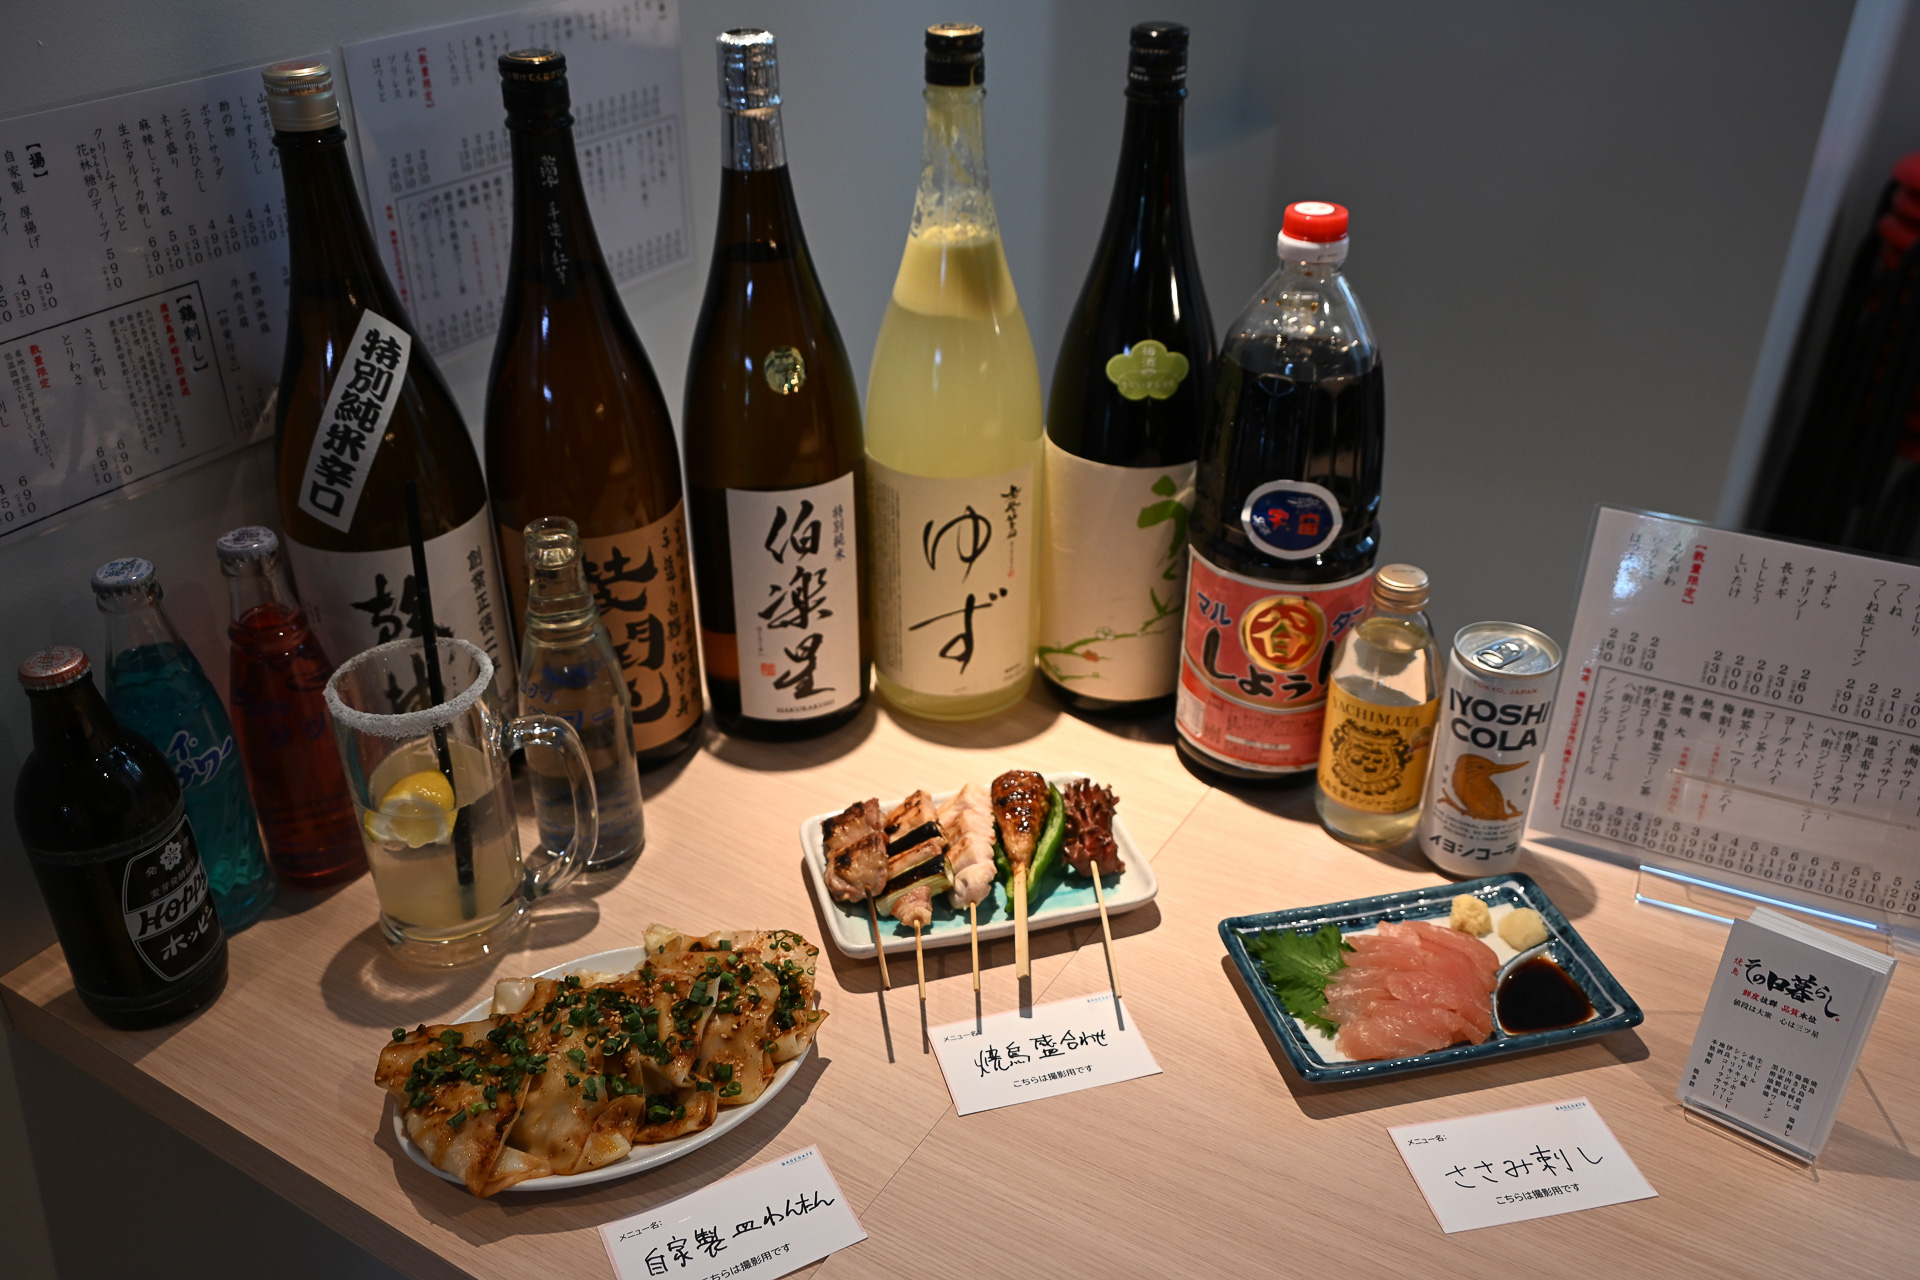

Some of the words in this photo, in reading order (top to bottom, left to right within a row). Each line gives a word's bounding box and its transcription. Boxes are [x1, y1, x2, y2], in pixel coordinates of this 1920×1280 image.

[218, 101, 236, 138] 酢の物
[239, 96, 262, 174] しらすおろし
[160, 114, 180, 169] ネギ盛り
[180, 109, 206, 193] ニラのおひたし
[199, 103, 225, 181] ポテトサラダ
[26, 142, 49, 179] 【揚】
[118, 123, 153, 229] 生ホタルイカ刺し
[138, 118, 173, 216] 麻辣しらす冷奴
[76, 144, 111, 243] 花林糖のディップ
[94, 128, 128, 232] クリームチーズと
[5, 151, 27, 195] 自家製
[20, 205, 42, 250] 厚揚げ
[208, 219, 223, 258] 490
[227, 214, 241, 253] 450
[245, 209, 259, 247] 450
[264, 203, 277, 242] 450
[148, 236, 165, 276] 690
[169, 230, 185, 270] 590
[188, 225, 204, 264] 530
[106, 248, 123, 289] 590
[17, 275, 36, 316] 490
[40, 267, 58, 309] 490
[176, 293, 209, 373] 【鶏刺し】
[29, 344, 52, 390] 数量限定
[62, 334, 83, 386] とりわさ
[84, 327, 108, 391] ささみ刺し
[308, 327, 403, 517] 特別純米辛口
[95, 447, 113, 484] 690
[116, 439, 133, 476] 690
[18, 476, 37, 514] 690
[908, 504, 1008, 676] ゆず
[1681, 543, 1709, 606] 【数量限定】
[1727, 552, 1748, 599] しいたけ
[1752, 557, 1767, 605] ししとう
[1774, 561, 1794, 600] 長ネギ
[1820, 571, 1837, 609] うずら
[1196, 590, 1233, 627] マル
[1796, 566, 1818, 621] チョリソー
[1888, 582, 1910, 617] つくね
[1851, 578, 1887, 667] つくね生ピーマン
[1602, 627, 1619, 663] 260
[1623, 631, 1640, 668] 290
[1643, 635, 1660, 672] 230
[1706, 649, 1724, 686] 230
[1728, 654, 1745, 691] 200
[1749, 659, 1767, 695] 200
[1771, 664, 1789, 700] 230
[1509, 687, 1538, 696] JAPAN
[1793, 668, 1811, 705] 260
[1838, 678, 1856, 715] 290
[1860, 683, 1878, 719] 230
[1332, 695, 1421, 729] YACHIMATA
[1449, 686, 1551, 726] IYOSHI
[1635, 684, 1657, 738] 伊良コーラ
[1679, 693, 1695, 719] 熱燗
[1699, 698, 1715, 723] 熱燗
[1717, 702, 1736, 740] 梅割り
[1883, 688, 1902, 725] 210
[1450, 717, 1538, 752] COLA
[1584, 675, 1617, 775] ノンアルコールビール
[1602, 681, 1637, 782] 八街ジンジャーエール
[1674, 726, 1687, 739] 大
[1750, 711, 1776, 770] コーン茶ハイ
[1768, 715, 1796, 785] ヨーグルトハイ
[1795, 720, 1815, 769] トマトハイ
[1852, 733, 1879, 804] 塩昆布サワー
[1876, 738, 1903, 800] バイスサワー
[1898, 743, 1920, 801] 梅肉サワー
[1573, 796, 1588, 829] 590
[1591, 801, 1606, 834] 590
[1610, 806, 1625, 839] 590
[1628, 811, 1644, 844] 450
[1429, 834, 1517, 861] イヨシコーラ
[1647, 816, 1662, 850] 990
[1666, 821, 1682, 854] 500
[1685, 826, 1701, 860] 390
[1704, 831, 1720, 864] 490
[1723, 836, 1739, 869] 490
[1743, 841, 1760, 875] 510
[1763, 846, 1779, 880] 510
[1783, 851, 1800, 885] 690
[1804, 856, 1820, 890] 690
[1824, 861, 1841, 895] 510
[1844, 866, 1861, 900] 520
[1865, 871, 1882, 905] 510
[1885, 876, 1902, 911] 520
[1730, 956, 1744, 977] 焼鳥
[1744, 957, 1841, 1019] その日暮らし
[1732, 998, 1774, 1020] 値段は大衆
[1779, 1017, 1820, 1040] 心は三ツ星
[1741, 988, 1779, 1008] 鮮度抜群
[1781, 1004, 1818, 1025] 品質本位
[1703, 1038, 1719, 1066] 本格焼酎
[1716, 1041, 1726, 1056] 地酒
[1746, 1054, 1756, 1069] 赤星
[1012, 1063, 1094, 1088] こちらは撮影用です
[1688, 1067, 1700, 1089] 他多数
[1711, 1043, 1734, 1096] 伊良コーラサワー
[1719, 1048, 1740, 1100] シャリキンサワー
[1724, 1051, 1748, 1109] シャリキンホッピー
[1749, 1056, 1764, 1084] 生ビール
[1779, 1070, 1794, 1099] 牛肉豆腐
[1807, 1079, 1819, 1095] 焼鳥
[1555, 1101, 1588, 1112] BASEGATE
[1786, 1072, 1802, 1108] 鶏きも刺し
[1792, 1075, 1811, 1112] 鹿児島直送
[1784, 1116, 1796, 1137] 鶏刺し
[781, 1150, 815, 1168] BASEGATE
[1444, 1143, 1605, 1190] ささみ刺し
[1495, 1182, 1581, 1206] こちらは撮影用です
